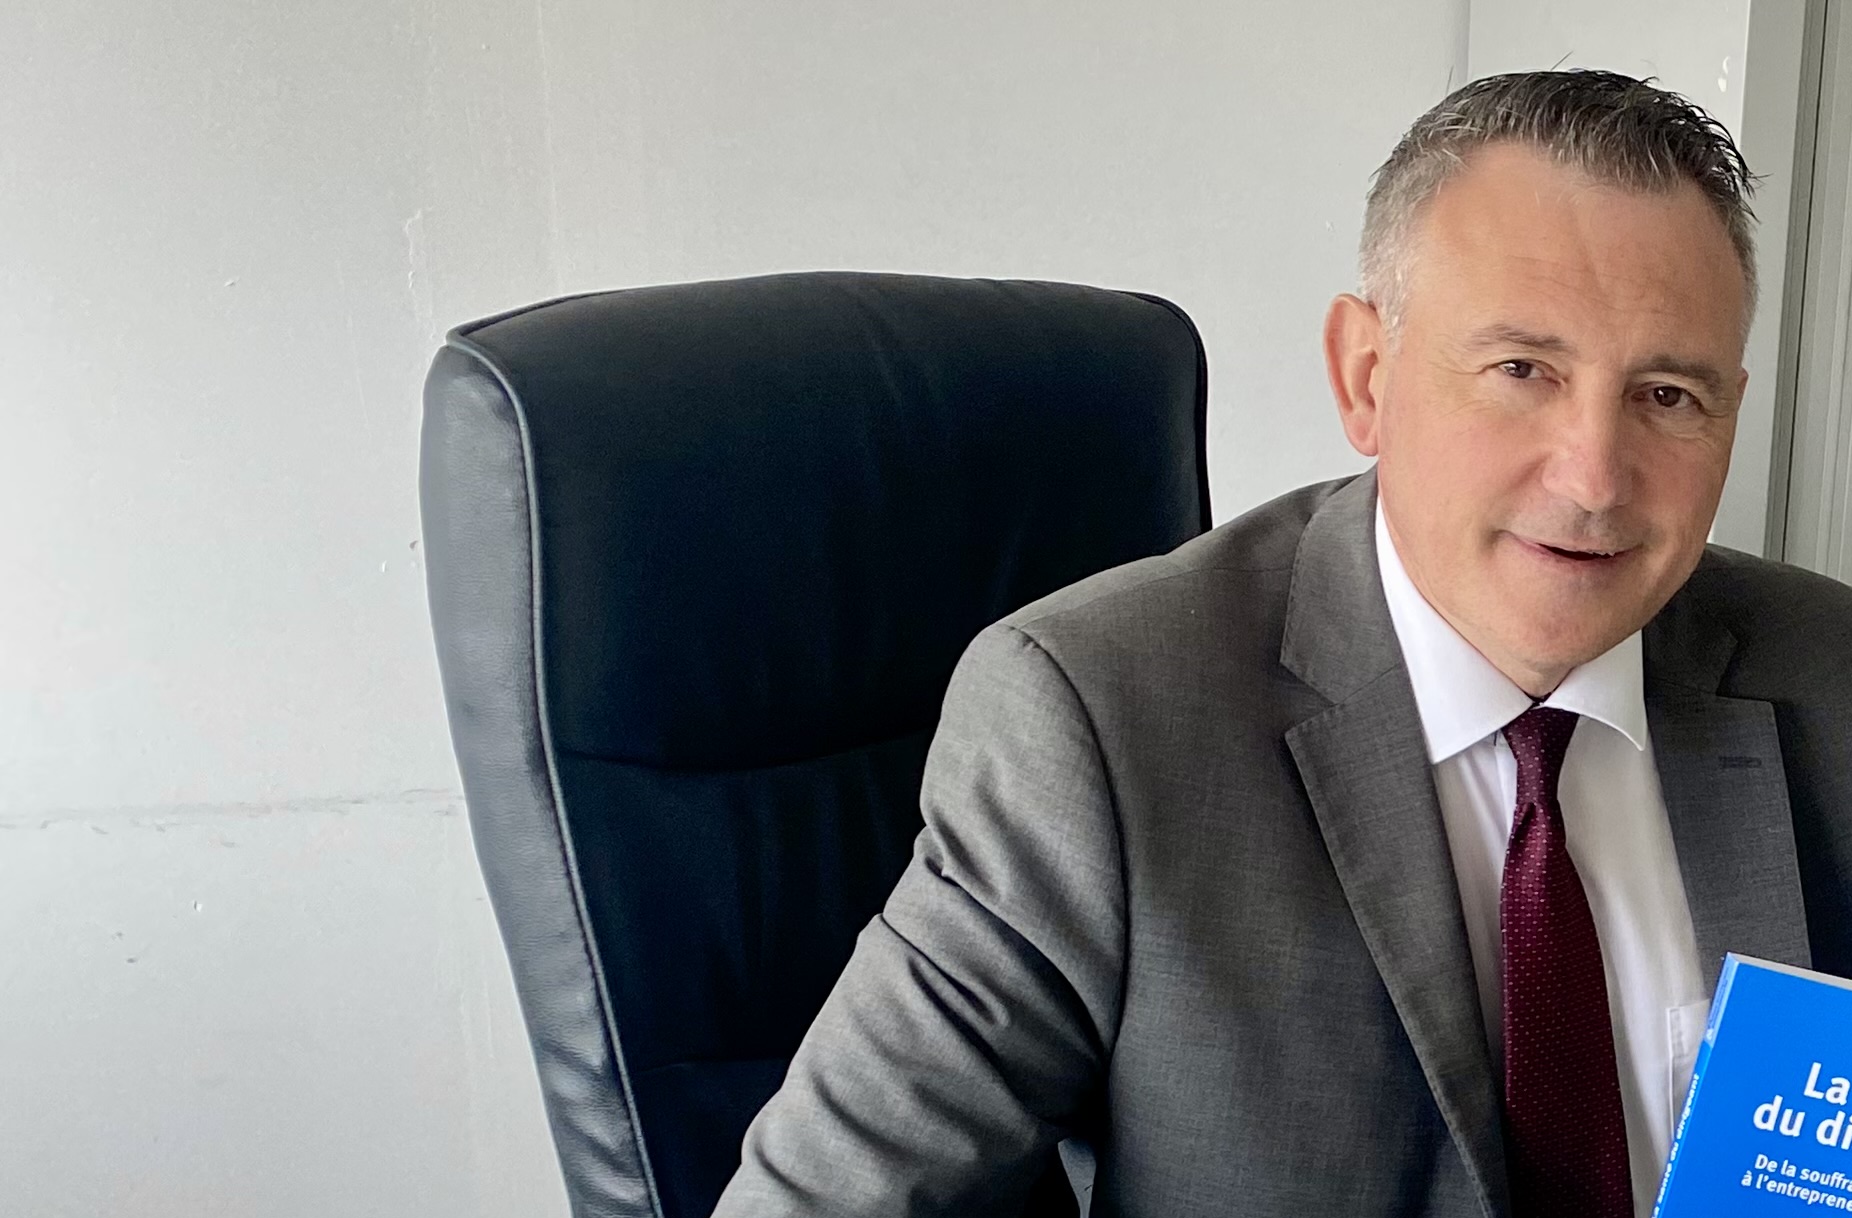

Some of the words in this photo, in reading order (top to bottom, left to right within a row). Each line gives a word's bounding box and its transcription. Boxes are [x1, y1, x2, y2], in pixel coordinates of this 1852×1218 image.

[1804, 1062, 1850, 1106] La
[1753, 1094, 1803, 1138] du
[1741, 1170, 1752, 1187] à
[1755, 1153, 1778, 1174] De
[1781, 1160, 1796, 1178] la
